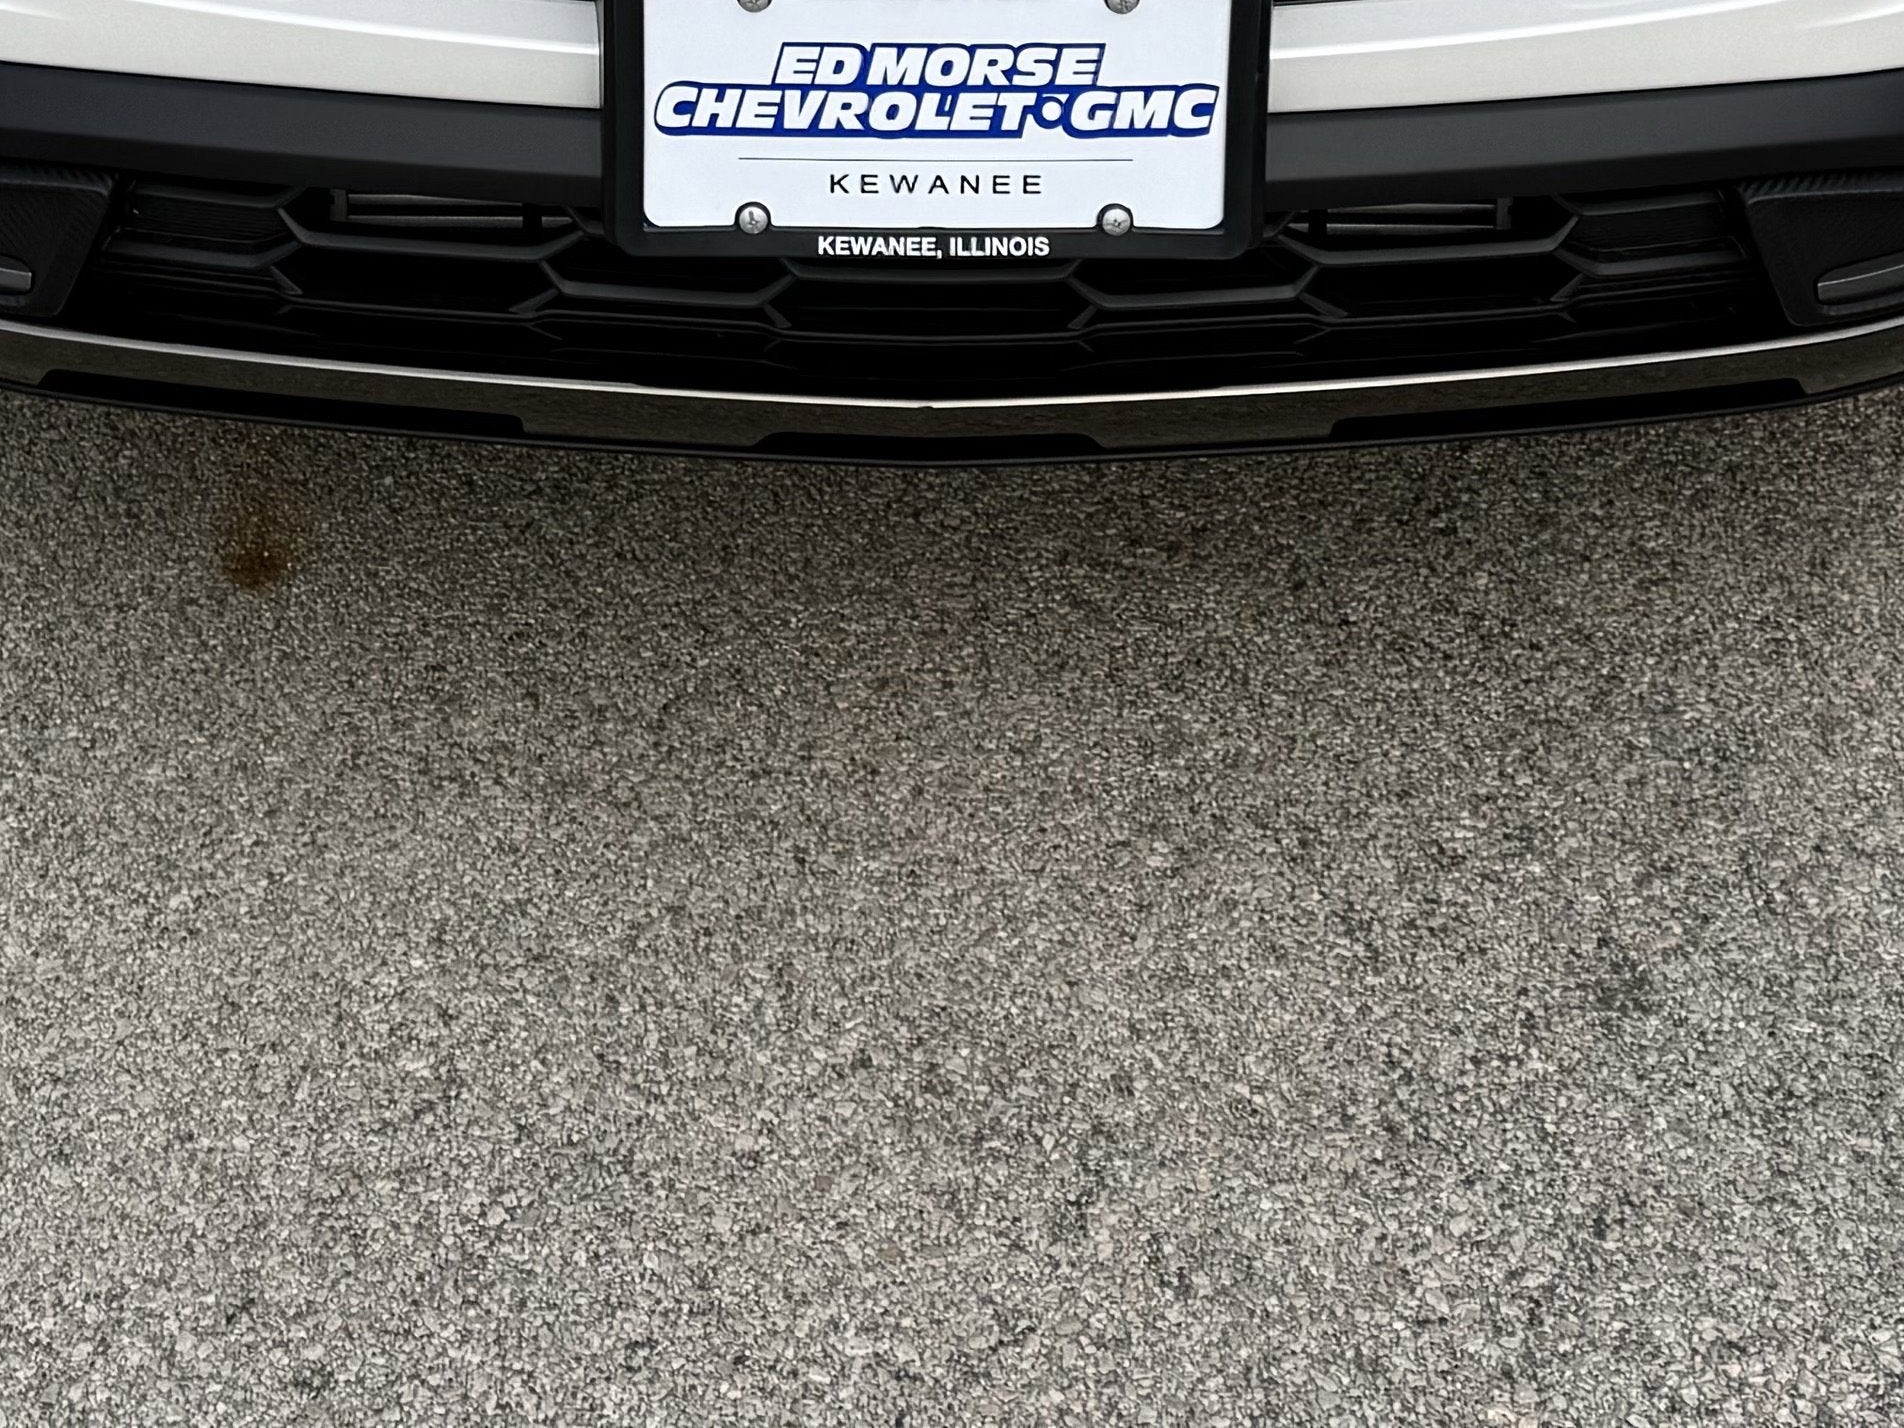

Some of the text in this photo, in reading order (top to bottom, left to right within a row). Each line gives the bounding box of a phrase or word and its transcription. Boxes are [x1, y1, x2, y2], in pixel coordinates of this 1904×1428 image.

[774, 45, 1101, 87] ED MORSE
[829, 173, 1042, 195] KEWANEE
[817, 235, 1050, 260] KEWANEE, ILLINOIS
